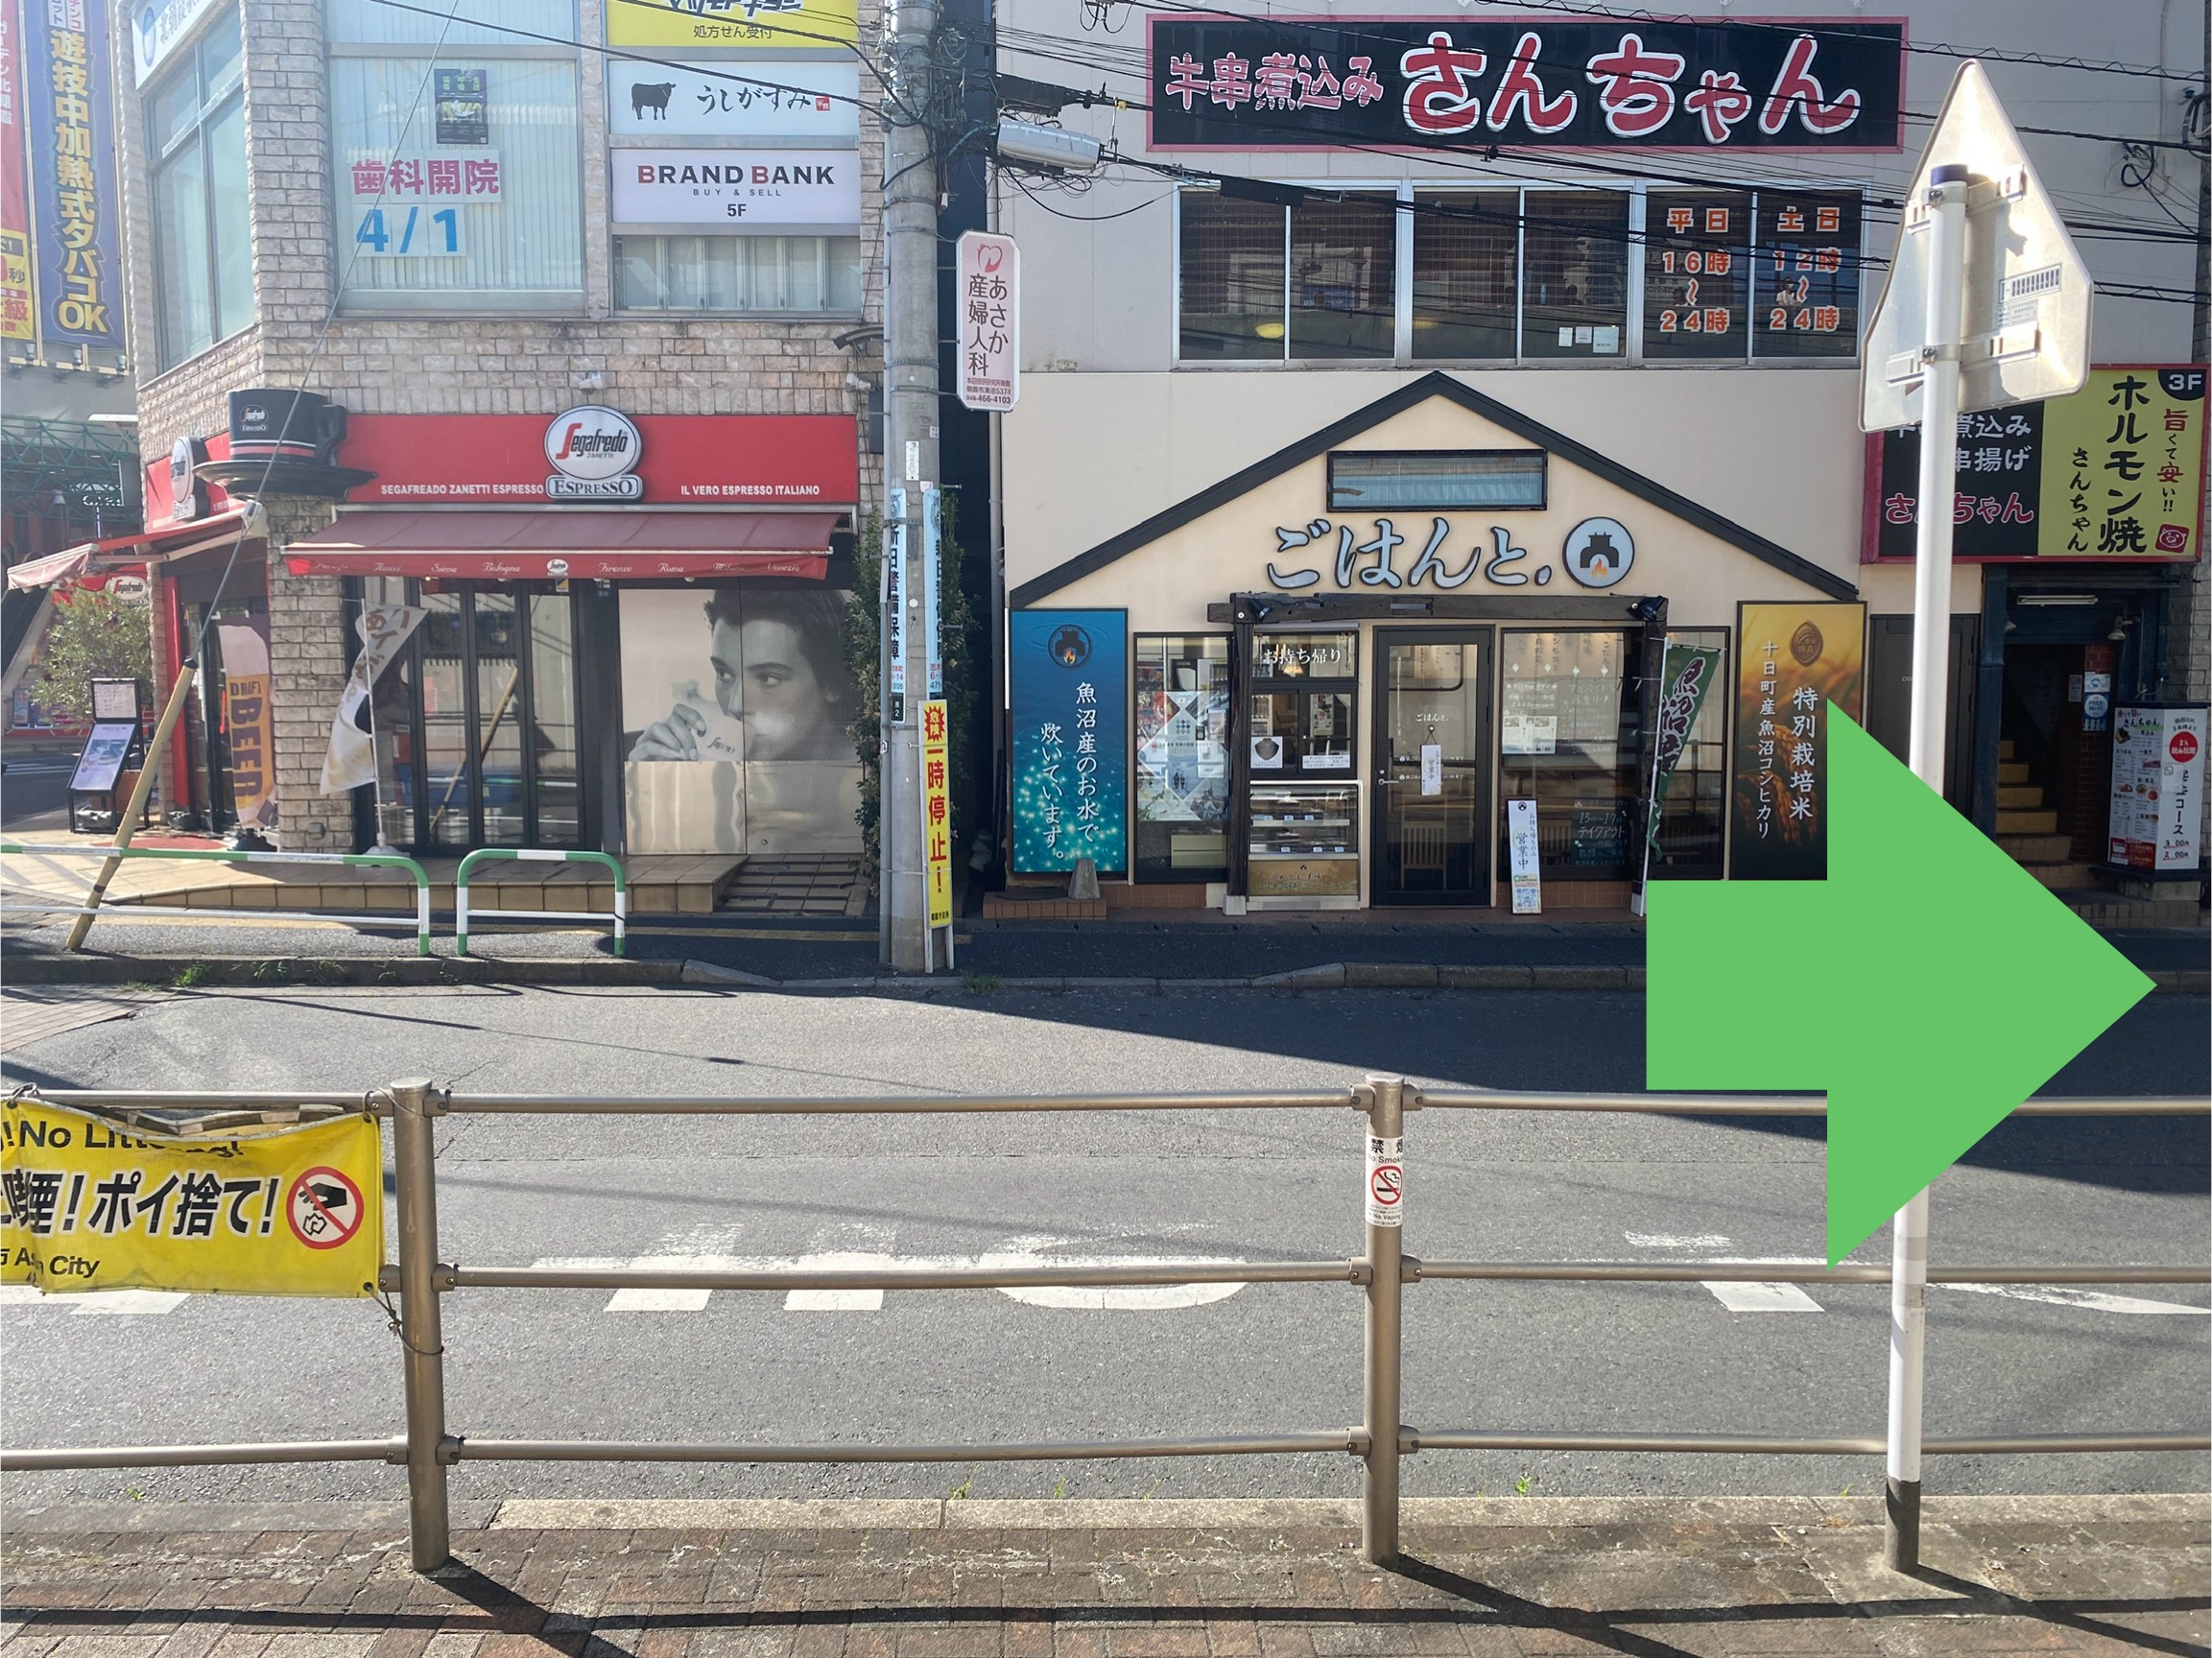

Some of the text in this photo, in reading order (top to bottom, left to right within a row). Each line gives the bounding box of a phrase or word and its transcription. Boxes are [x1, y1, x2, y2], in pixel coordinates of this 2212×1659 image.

[693, 25, 773, 39] 処方せん受付
[1164, 52, 1384, 112] 牛串煮込み
[1399, 31, 1863, 145] さんちゃん
[697, 84, 811, 115] うしがすみ
[50, 30, 107, 333] 遊技中加熱式タバコOK
[350, 159, 499, 196] 歯科開院
[637, 165, 835, 185] BRAND BANK
[726, 203, 747, 217] 5F
[1667, 207, 1729, 234] 平日
[1776, 205, 1840, 232] 土日
[356, 206, 458, 253] 4/1
[1662, 249, 1731, 276] 16時
[1773, 247, 1842, 273] 12時
[968, 273, 989, 377] 産婦人科
[989, 275, 1009, 354] あさか
[1660, 308, 1729, 334] 24時
[1770, 305, 1841, 332] 24時
[2168, 374, 2202, 391] 3F
[555, 423, 629, 460] Segafredo
[2098, 375, 2150, 554] ホルモン焼
[381, 485, 544, 495] SEGAFREADO ZANETTI ESPRESSO
[680, 486, 821, 495] IL VERO ESPRESSO ITALIANO
[2067, 447, 2091, 552] さんちゃん
[1886, 492, 2034, 524] さちゃん
[431, 563, 458, 573] Siena
[482, 562, 520, 574] Bologna
[598, 562, 631, 573] Firenze
[657, 563, 683, 573] Roma
[1263, 648, 1342, 665] お持ち帰り
[231, 697, 263, 796] BEER
[1756, 640, 1778, 839] 十日町産魚沼コシヒカリ
[1789, 686, 1819, 819] 特別栽培米
[1076, 681, 1099, 842] 魚沼産のお水で
[1040, 723, 1065, 859] 炊いています。
[927, 748, 947, 893] 一時停止!
[1578, 825, 1626, 839] テイクアウト
[1515, 832, 1529, 869] 営業中
[19, 1121, 71, 1148] No
[49, 1255, 100, 1278] City
